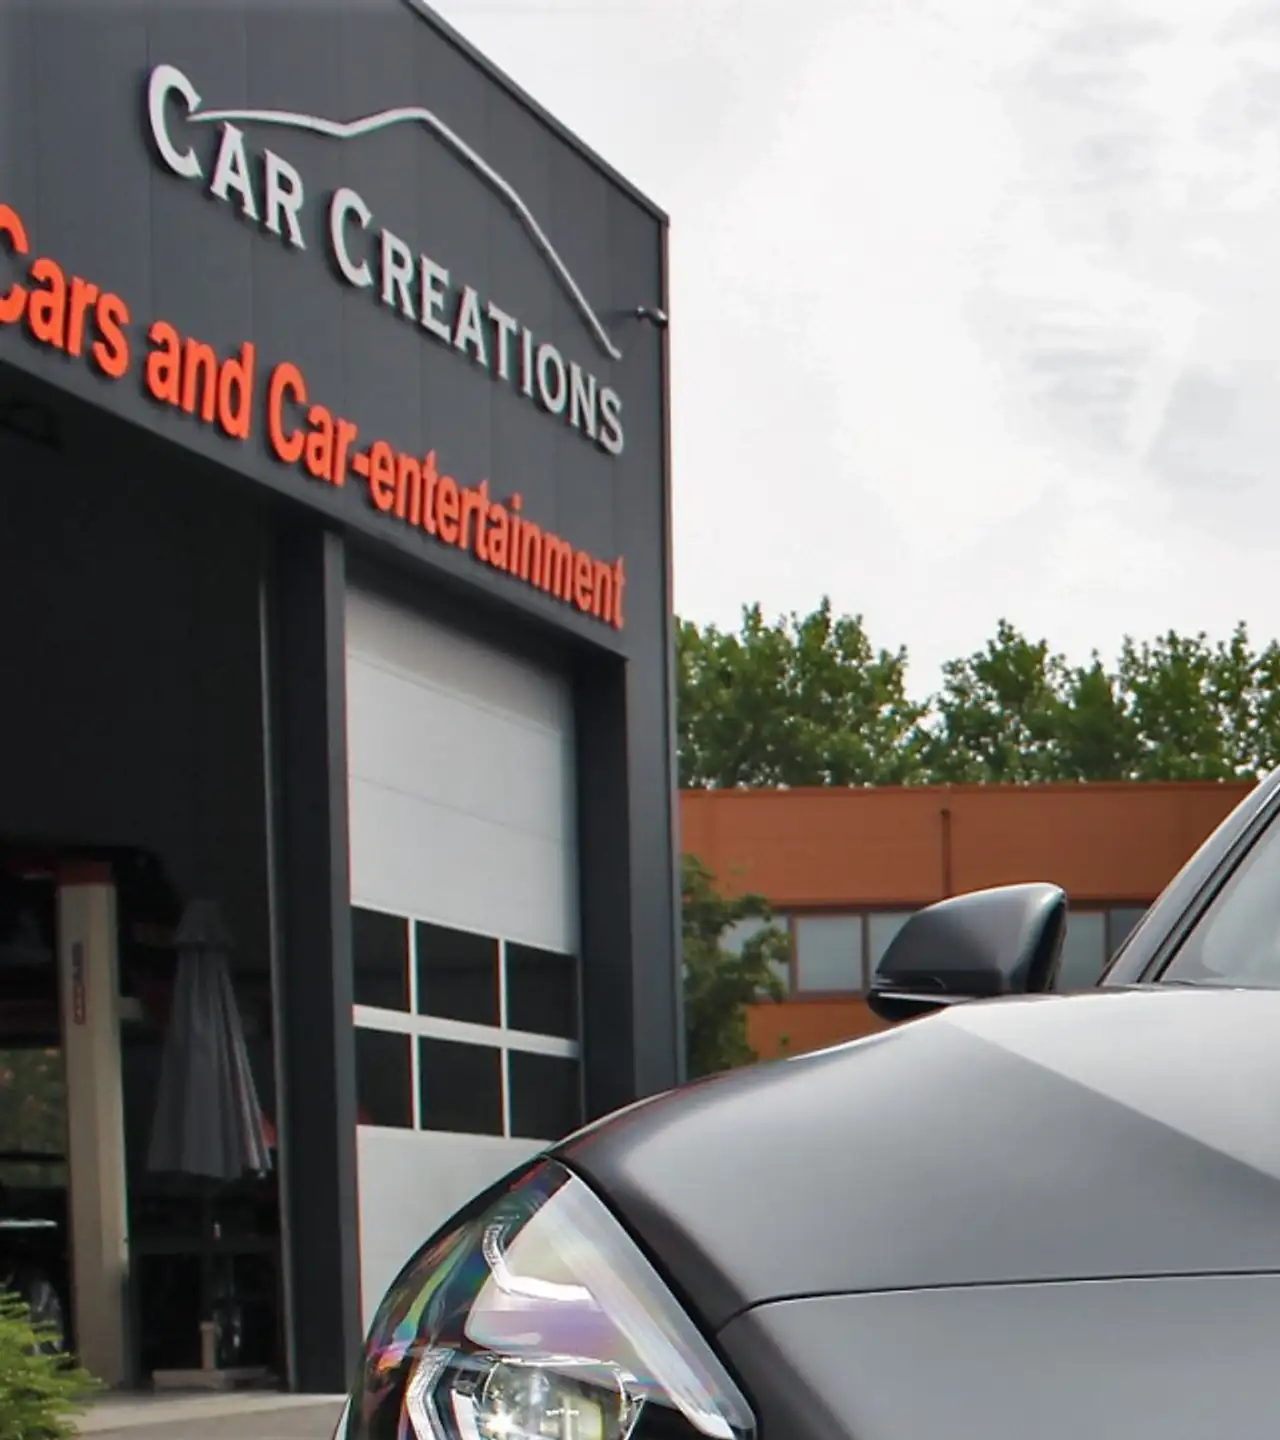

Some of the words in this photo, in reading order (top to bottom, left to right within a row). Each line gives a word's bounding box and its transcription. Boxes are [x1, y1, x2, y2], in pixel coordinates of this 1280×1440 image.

[148, 64, 305, 249] CAR
[330, 187, 625, 455] CREATIONS
[146, 320, 257, 440] and
[269, 361, 626, 628] Car-entertainment
